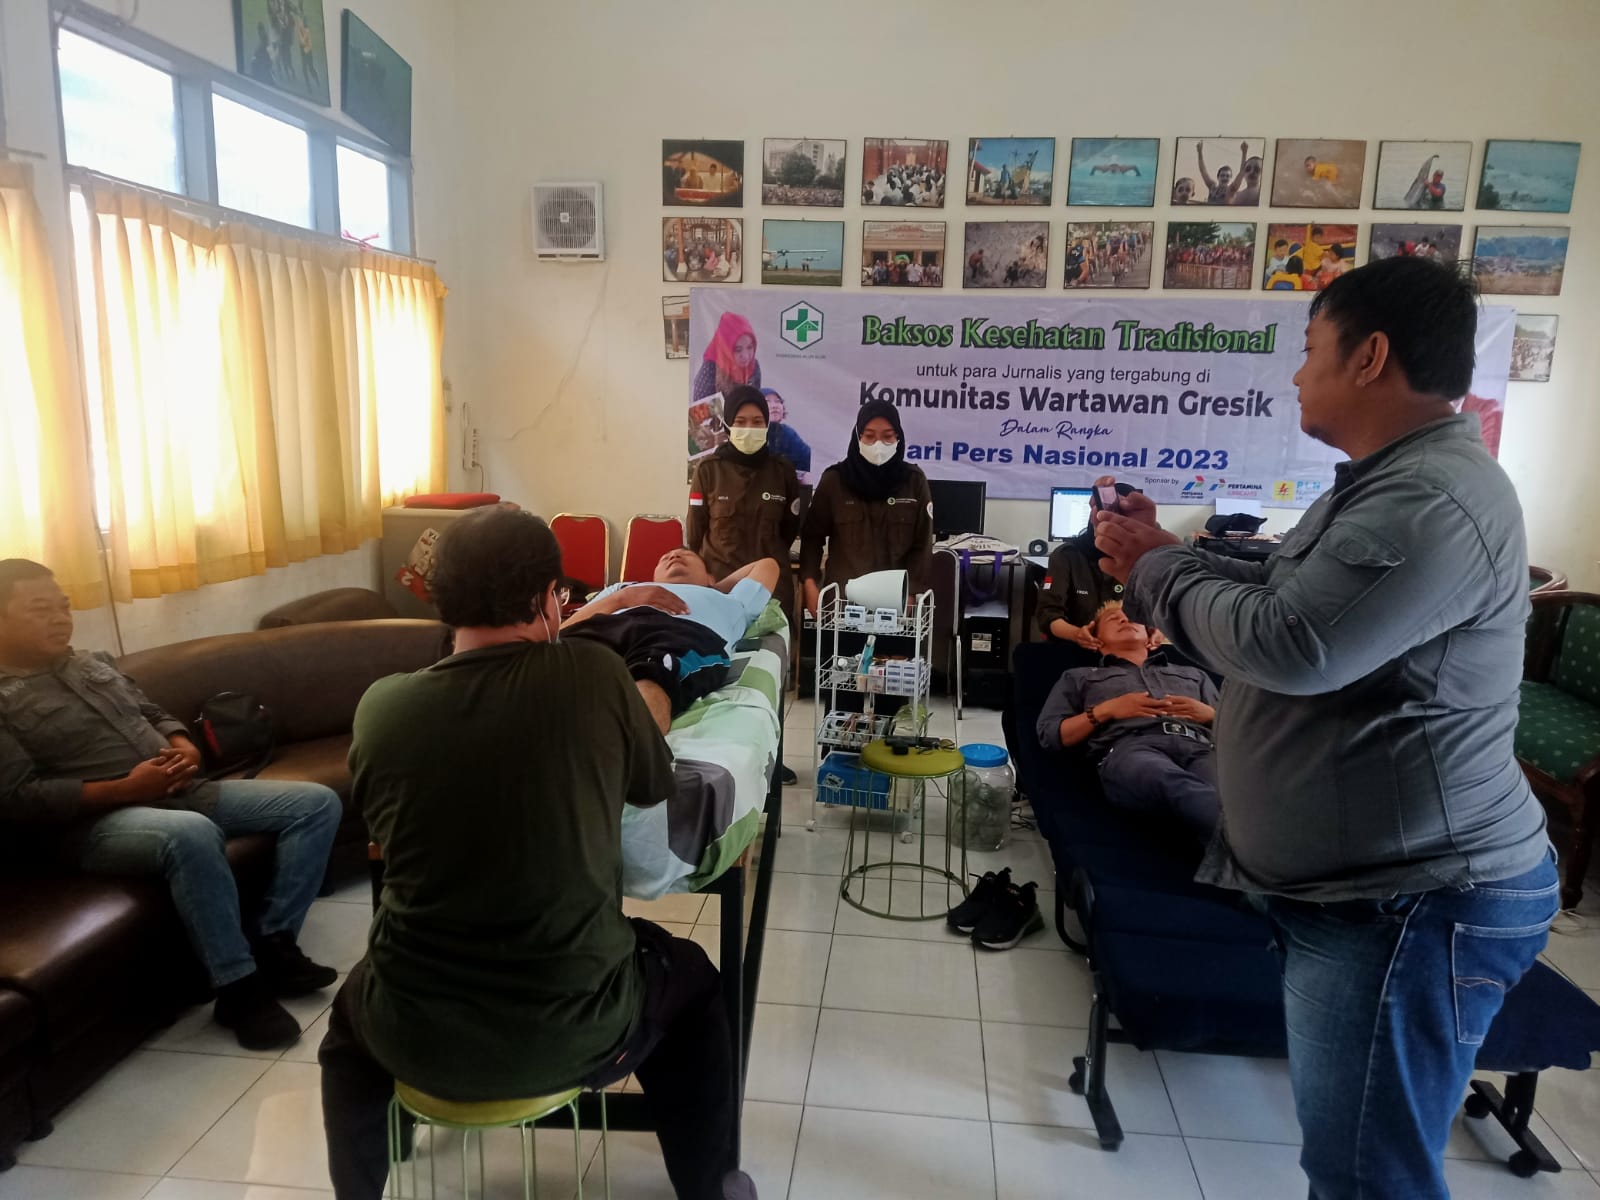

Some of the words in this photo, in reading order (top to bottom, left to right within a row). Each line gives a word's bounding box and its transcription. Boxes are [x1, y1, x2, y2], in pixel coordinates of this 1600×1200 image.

[861, 314, 953, 347] Baksos
[960, 317, 1105, 350] Kesehatan
[1113, 319, 1278, 354] Tradisional
[916, 364, 958, 377] untuk
[963, 366, 997, 380] para
[1002, 364, 1062, 380] Jurnalis
[1067, 369, 1105, 384] yang
[1110, 367, 1191, 386] tergabung
[1196, 368, 1210, 383] di
[859, 381, 1010, 410] Komunitas
[1020, 386, 1169, 415] Wartawan
[1178, 389, 1273, 417] Gresik
[1000, 419, 1053, 437] Dalam
[1056, 420, 1113, 440] Rangka
[906, 442, 942, 460] ari
[952, 442, 1013, 463] Pers
[1023, 444, 1147, 468] Nasional
[1156, 447, 1229, 471] 2023
[1144, 476, 1170, 484] Sponsor
[1171, 477, 1179, 485] by
